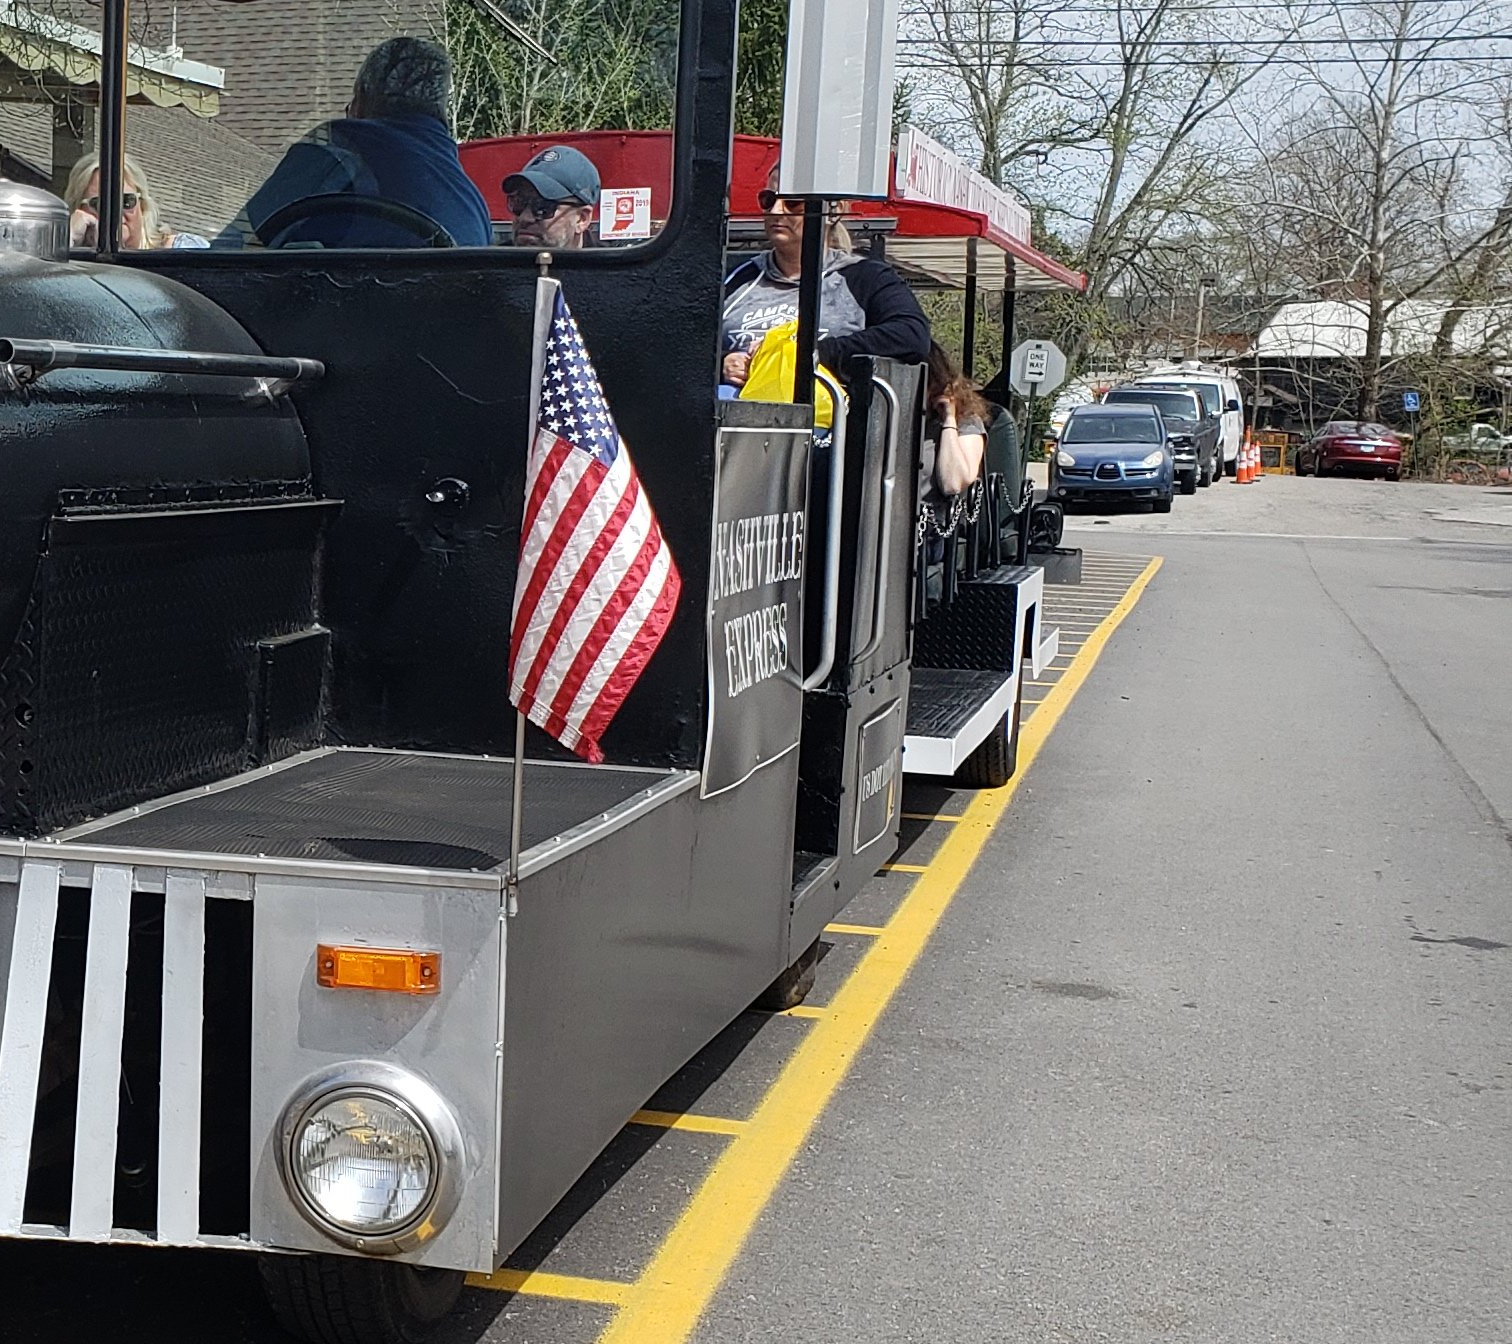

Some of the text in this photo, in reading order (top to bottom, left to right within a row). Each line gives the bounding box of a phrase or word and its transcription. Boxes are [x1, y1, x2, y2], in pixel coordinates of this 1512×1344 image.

[1029, 361, 1044, 369] WAY
[714, 510, 804, 601] NASHVILLE
[724, 602, 788, 698] EXPRESS
